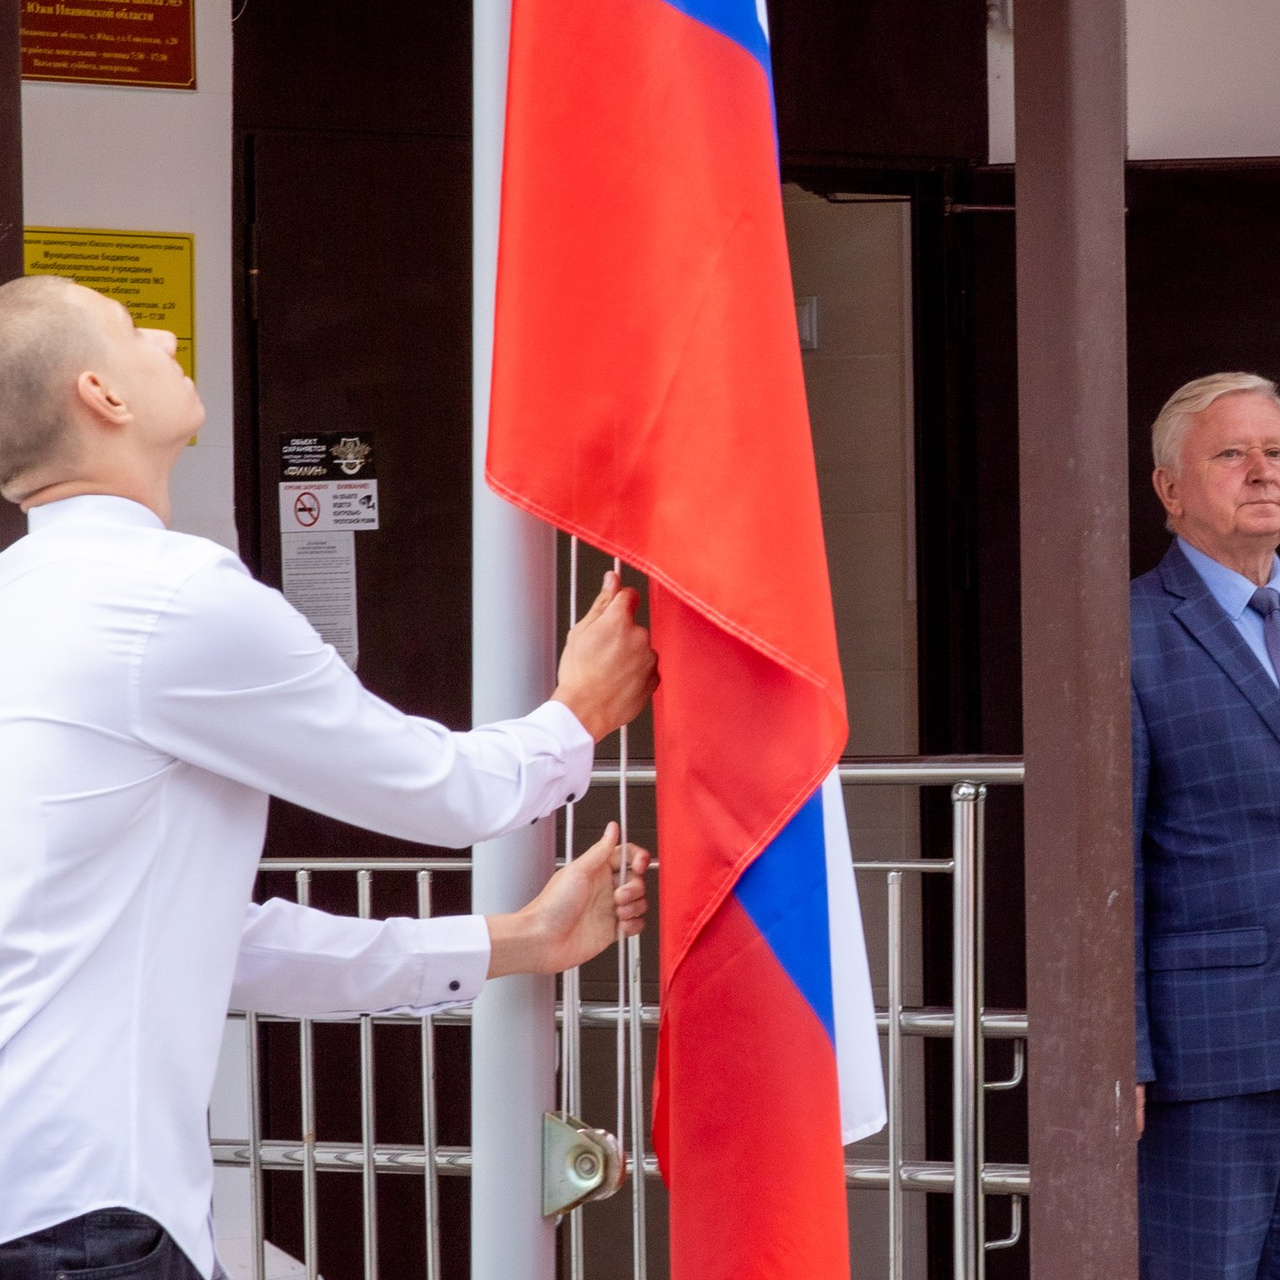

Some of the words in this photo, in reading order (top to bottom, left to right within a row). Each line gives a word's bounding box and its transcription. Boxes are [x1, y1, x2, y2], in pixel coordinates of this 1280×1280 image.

[55, 4, 114, 19] Ивановской
[115, 8, 154, 21] области
[111, 285, 141, 295] области
[290, 438, 319, 446] ОБЪЕКТ
[282, 445, 327, 453] ОХРАНЯЕТСЯ
